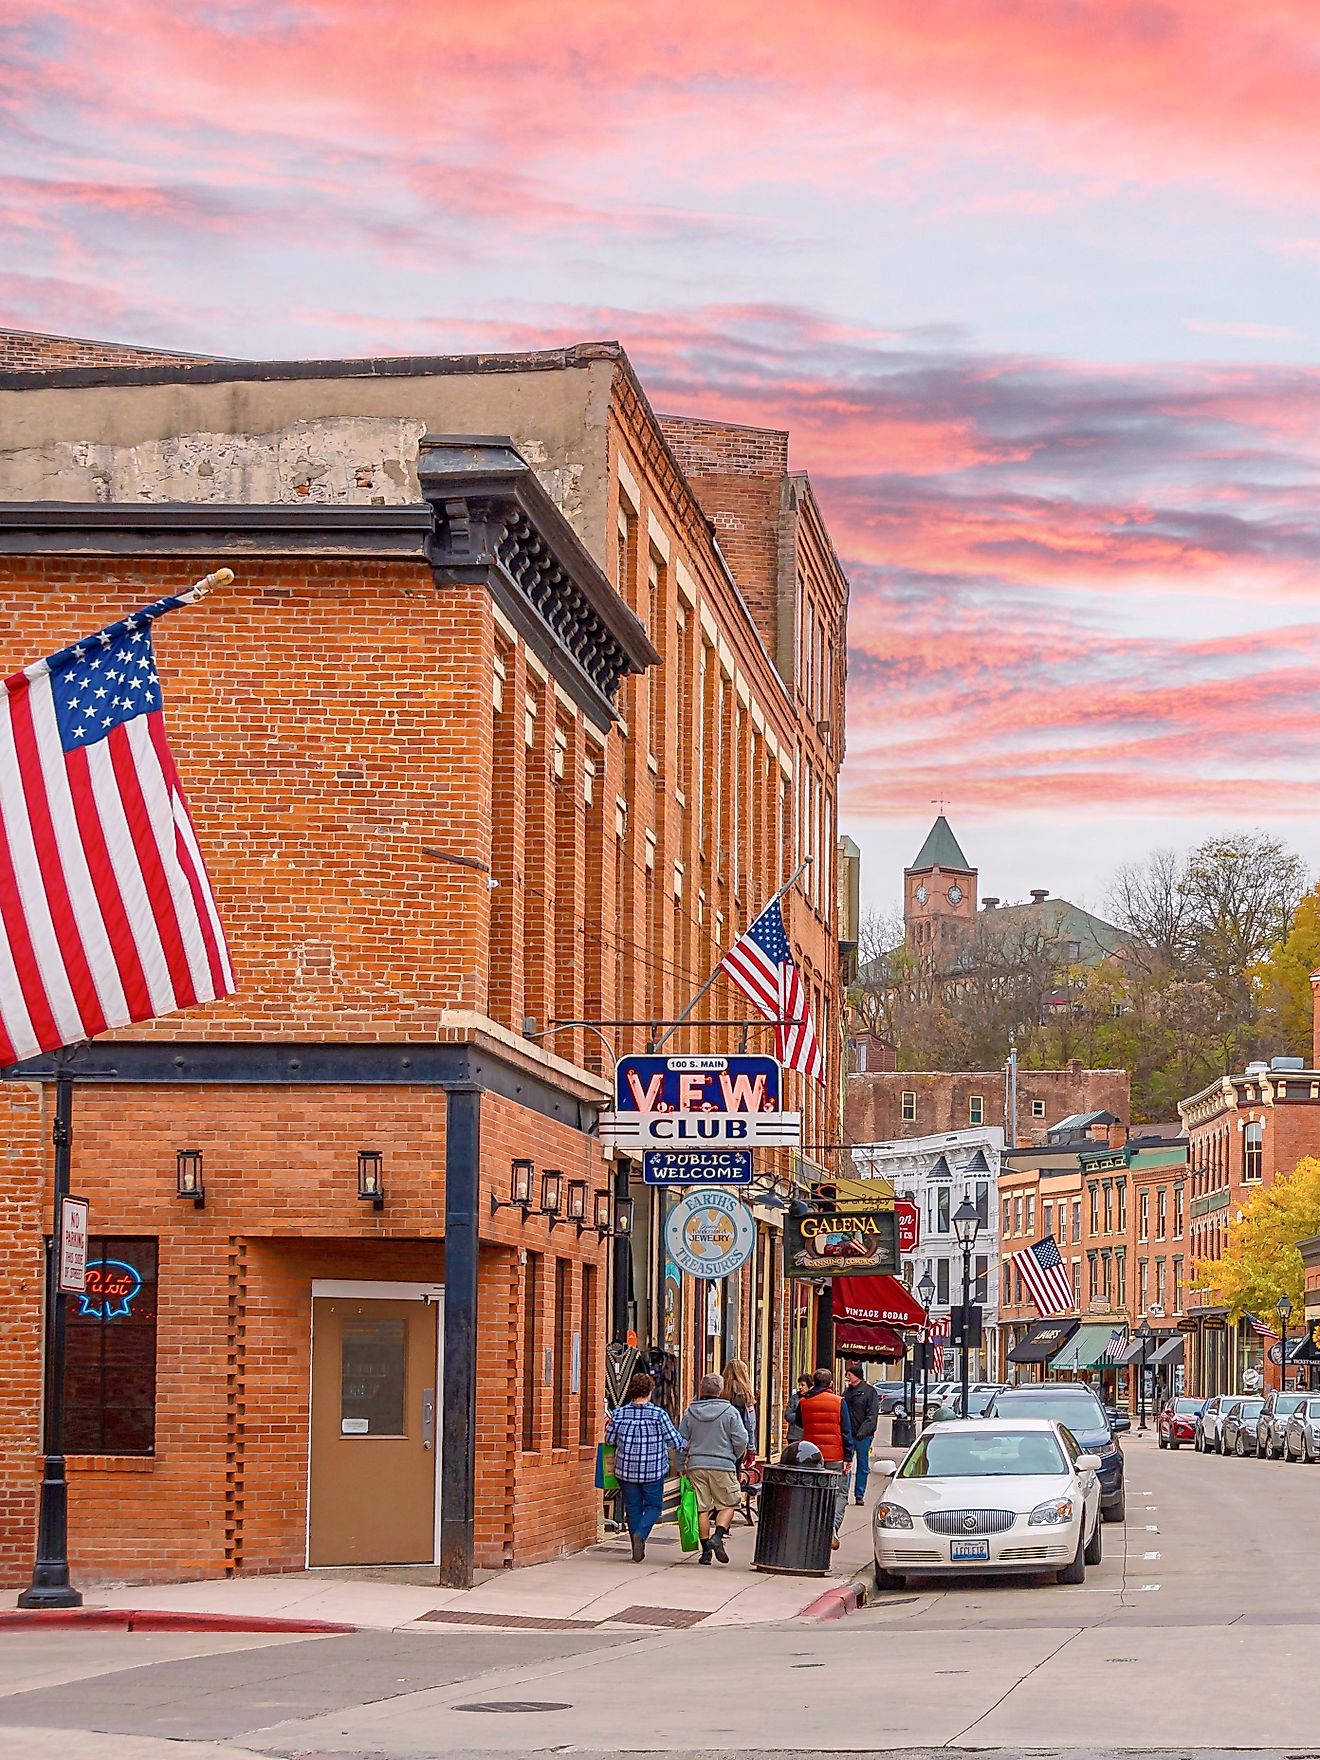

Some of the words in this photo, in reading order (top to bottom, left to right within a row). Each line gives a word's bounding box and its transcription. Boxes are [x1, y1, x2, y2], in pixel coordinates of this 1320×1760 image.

[649, 1118, 748, 1139] CLUB
[665, 1154, 731, 1165] PUBLIC
[652, 1167, 744, 1179] WELCOME
[685, 1194, 737, 1212] EARTH'S
[70, 1211, 80, 1229] NO
[801, 1216, 881, 1238] GALENA
[65, 1230, 84, 1249] PARKING
[688, 1234, 730, 1242] JEWELRY
[65, 1251, 74, 1264] THIS
[75, 1253, 84, 1265] SIDE
[675, 1247, 743, 1275] TREASURES
[807, 1259, 842, 1267] CANNING
[845, 1307, 879, 1319] VINTAGE
[882, 1311, 909, 1320] SODAS
